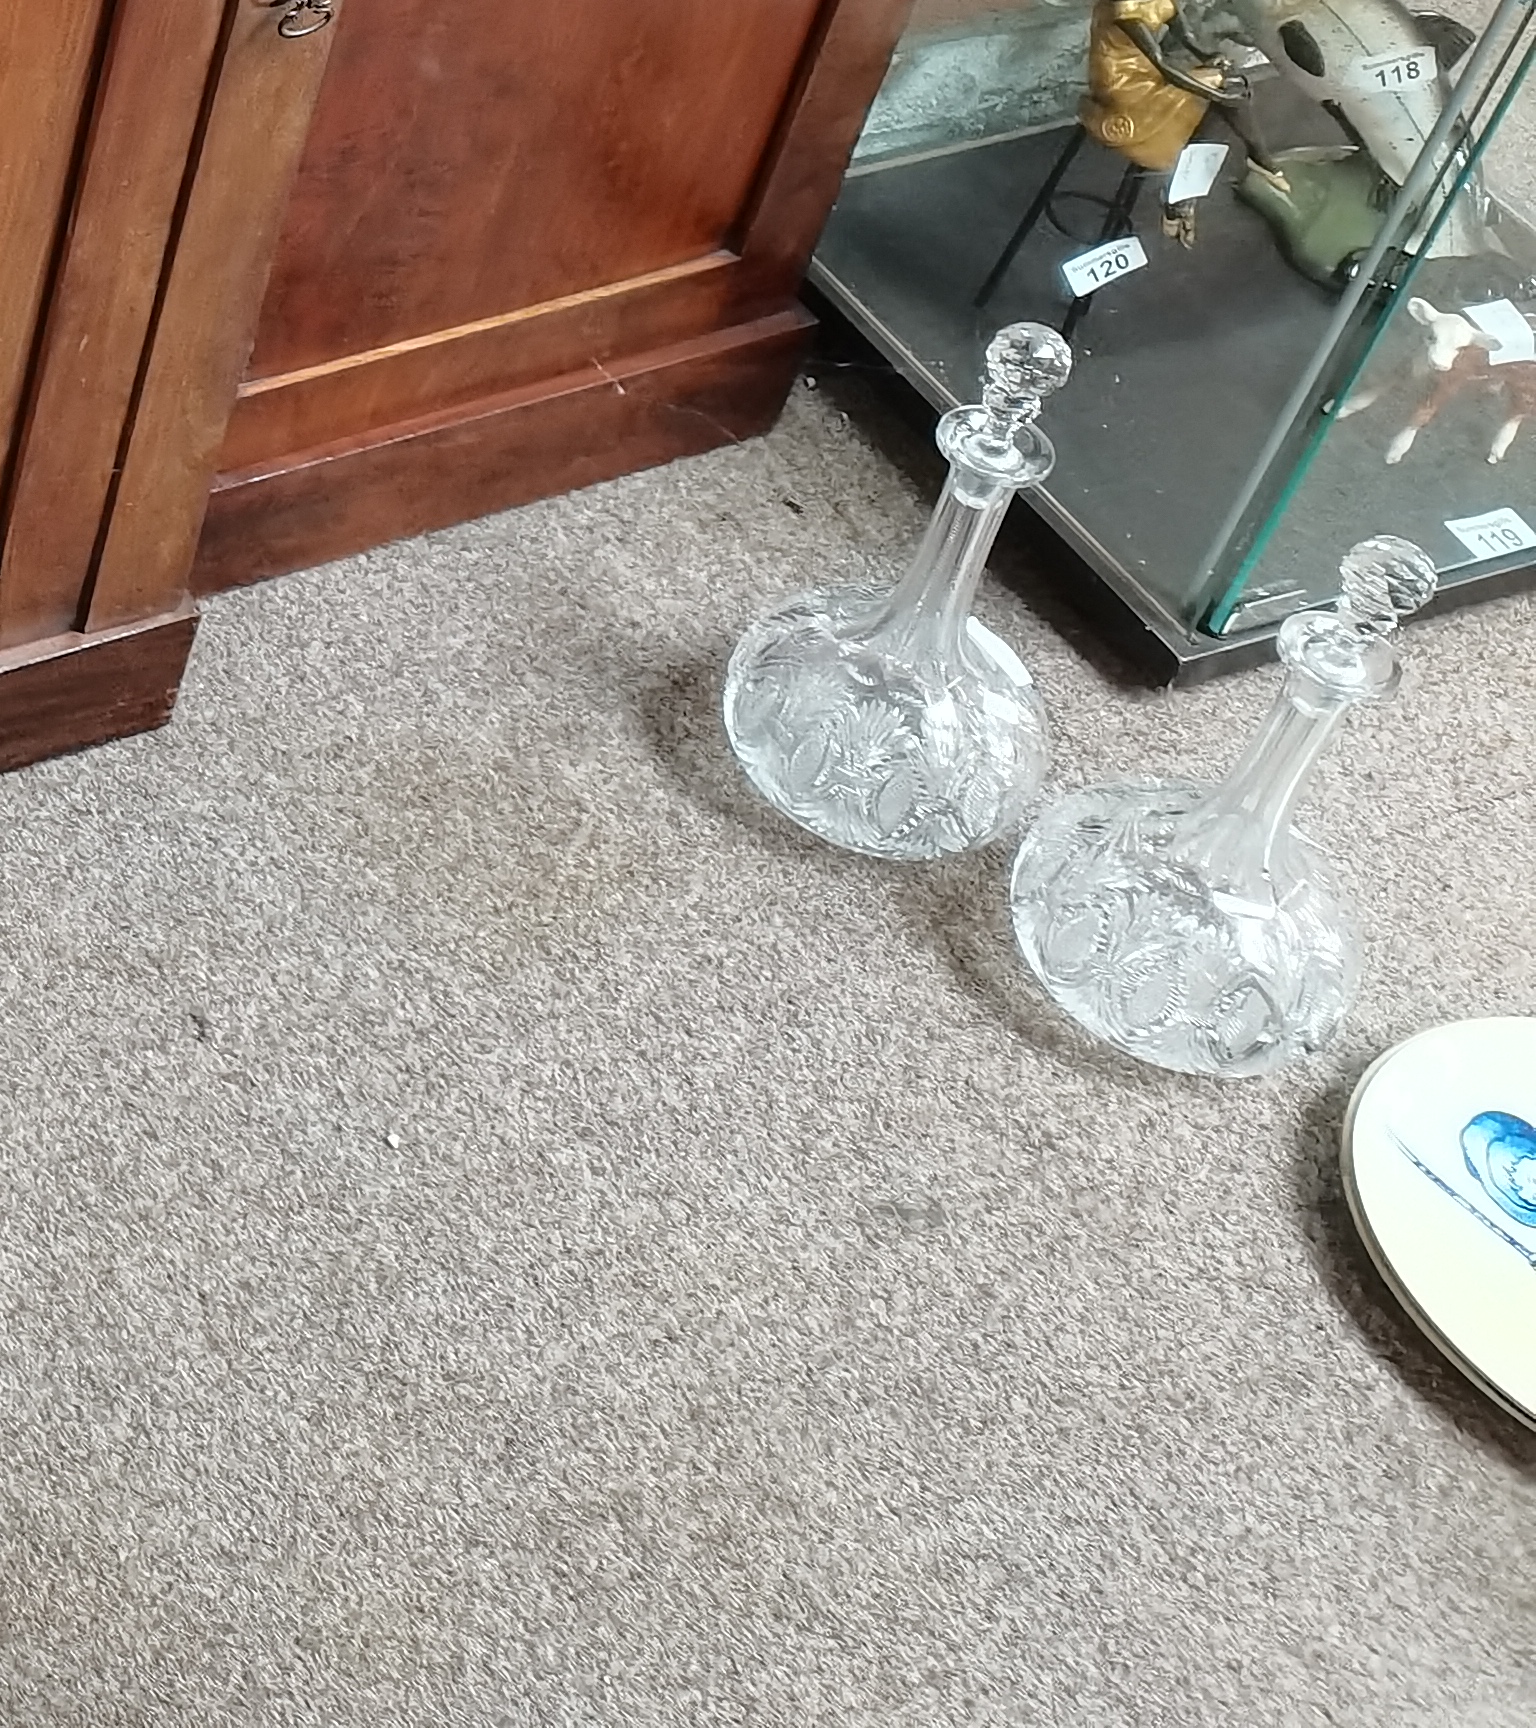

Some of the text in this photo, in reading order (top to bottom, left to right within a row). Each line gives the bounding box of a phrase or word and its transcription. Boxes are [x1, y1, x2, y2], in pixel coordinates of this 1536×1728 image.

[1374, 60, 1421, 87] 118
[1086, 253, 1129, 283] 120
[1477, 527, 1524, 553] 119
